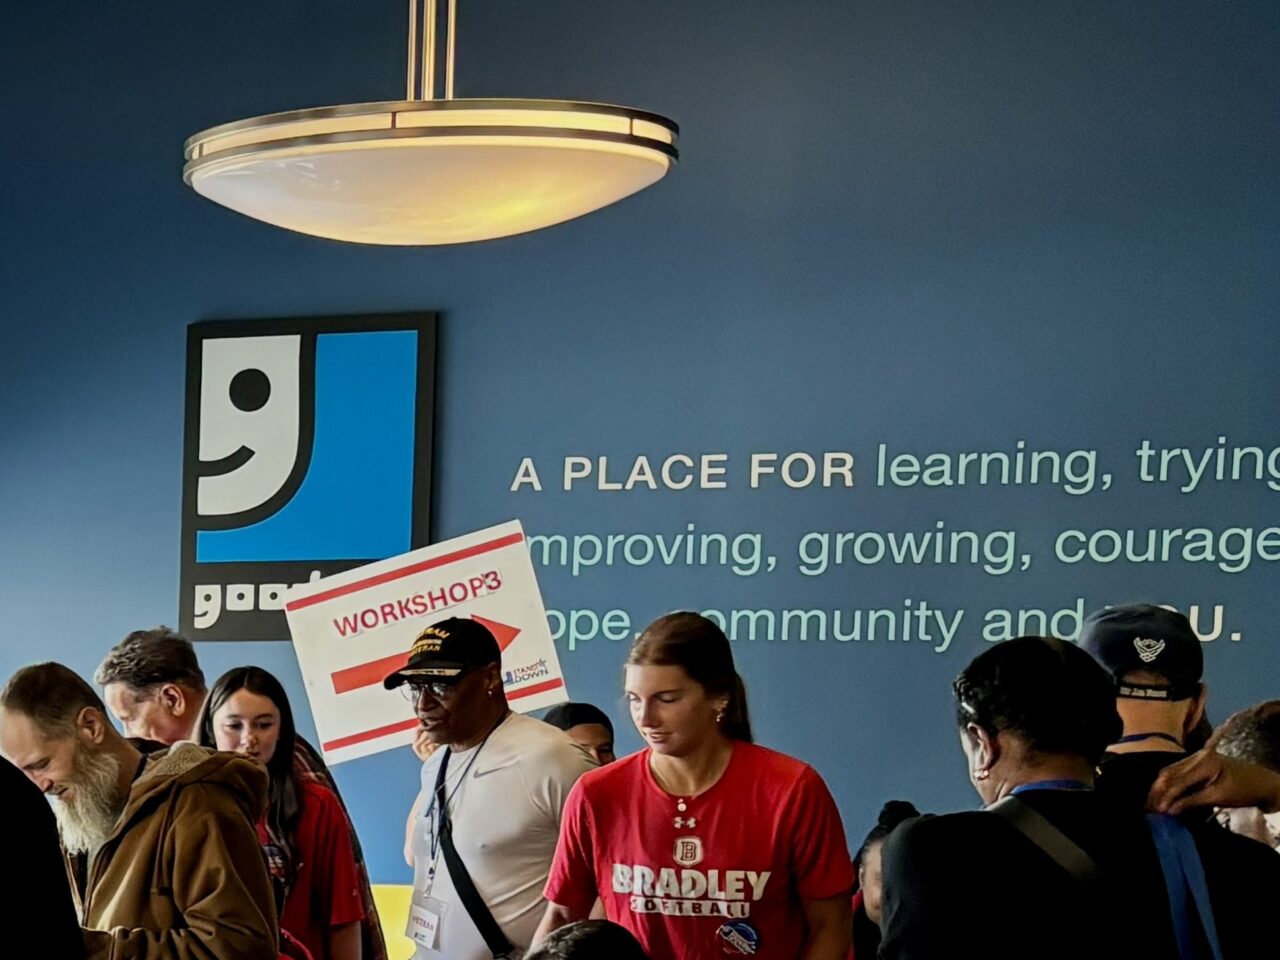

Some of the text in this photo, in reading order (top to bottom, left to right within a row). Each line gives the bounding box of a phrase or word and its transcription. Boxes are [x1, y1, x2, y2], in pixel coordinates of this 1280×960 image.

[510, 457, 543, 491] A
[563, 453, 728, 491] PLACE
[749, 451, 855, 489] FOR
[876, 440, 1113, 495] learning,
[527, 523, 777, 576] mproving,
[798, 520, 1032, 576] growing,
[670, 598, 965, 653] ommunity
[981, 598, 1085, 641] and
[680, 841, 697, 862] B
[612, 863, 772, 901] BRADLEY
[631, 898, 750, 918] SOFTBALL
